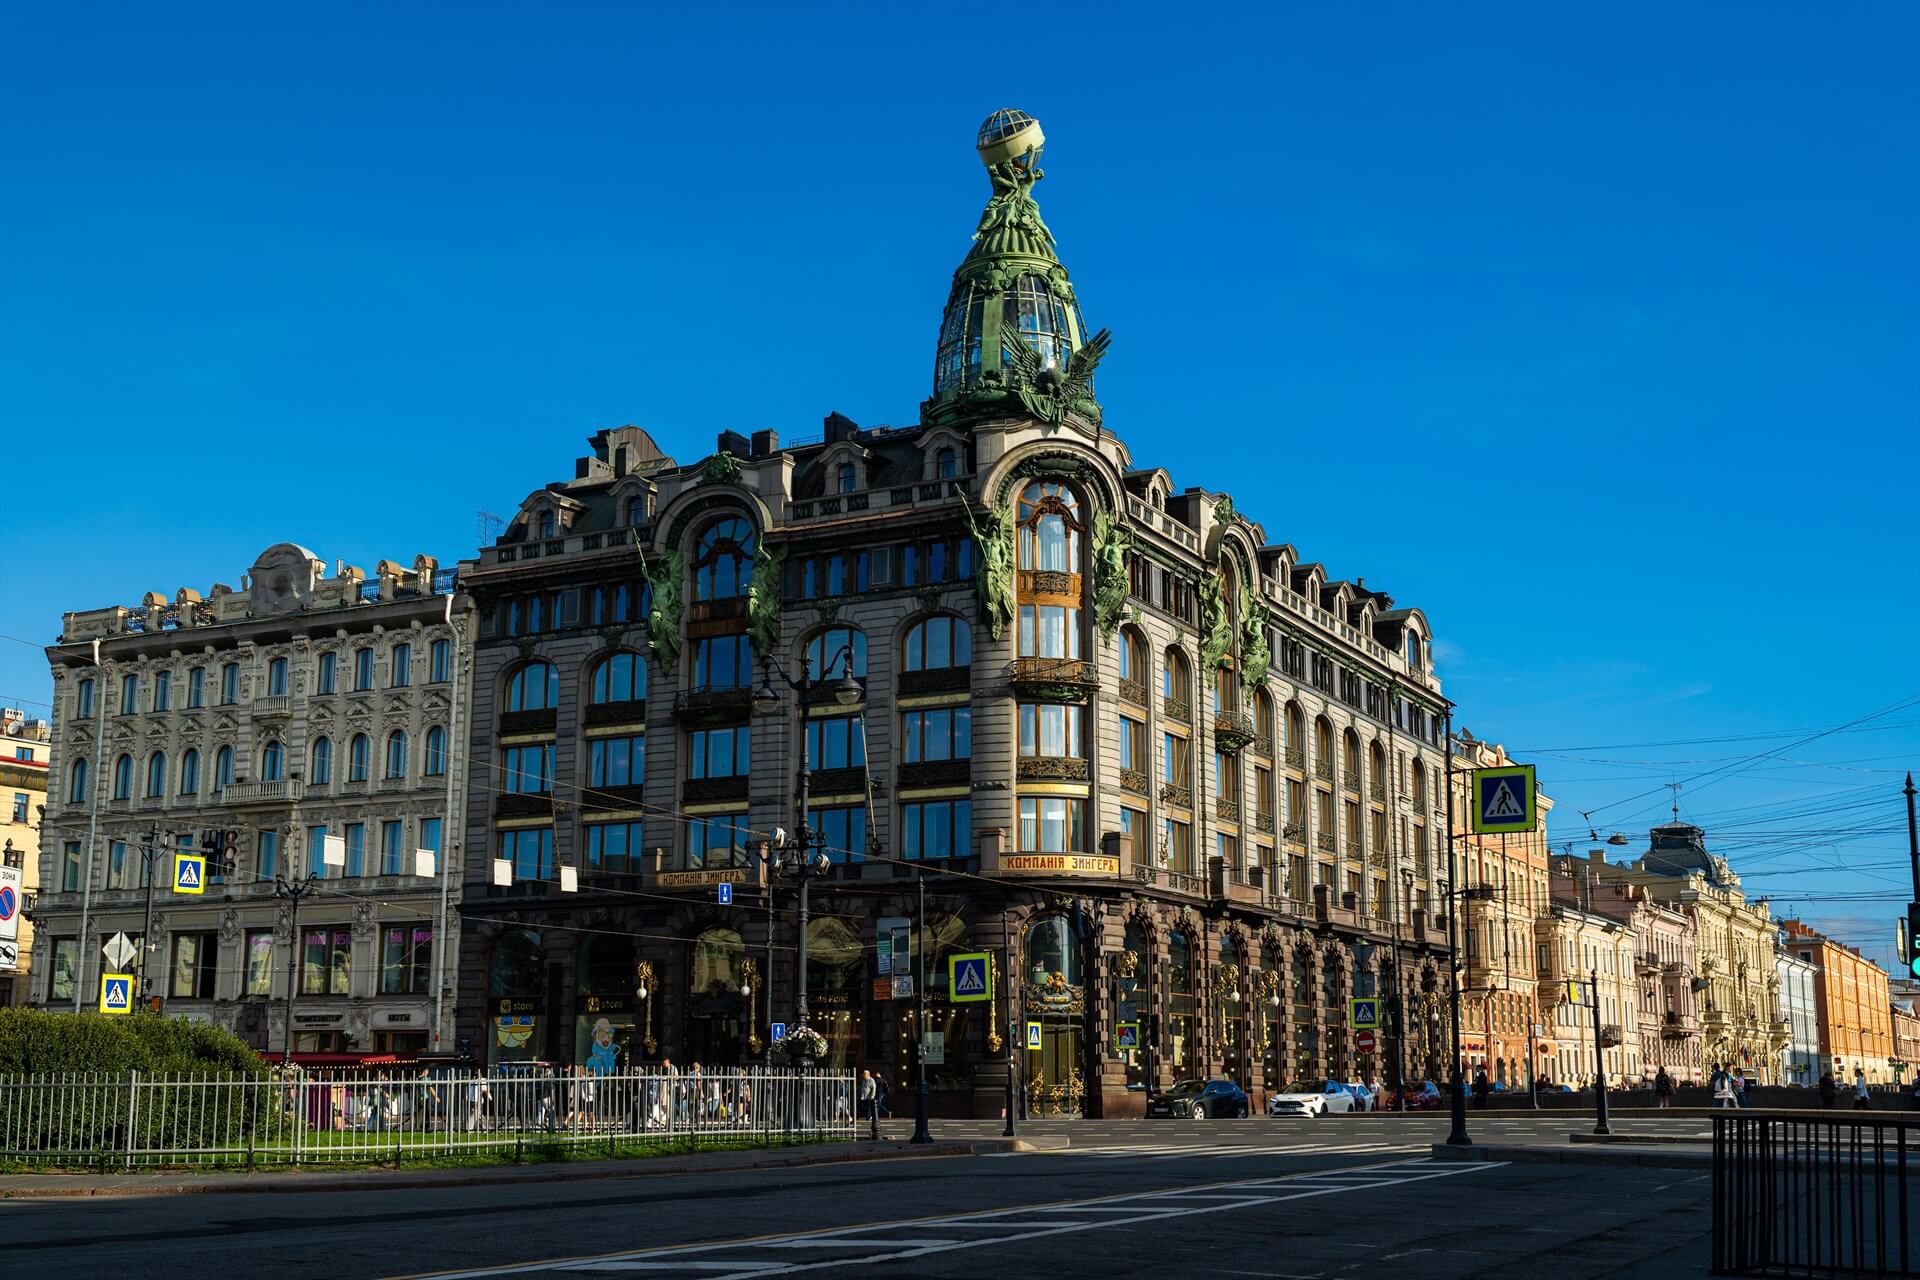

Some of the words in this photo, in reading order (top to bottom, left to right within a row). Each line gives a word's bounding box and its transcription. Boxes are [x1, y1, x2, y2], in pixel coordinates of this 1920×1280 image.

[1007, 857, 1064, 869] КОМПАНІЯ
[2, 871, 16, 881] ЗОНА
[663, 872, 702, 886] КОМПАНІЯ
[512, 1000, 535, 1010] store
[601, 999, 624, 1009] store
